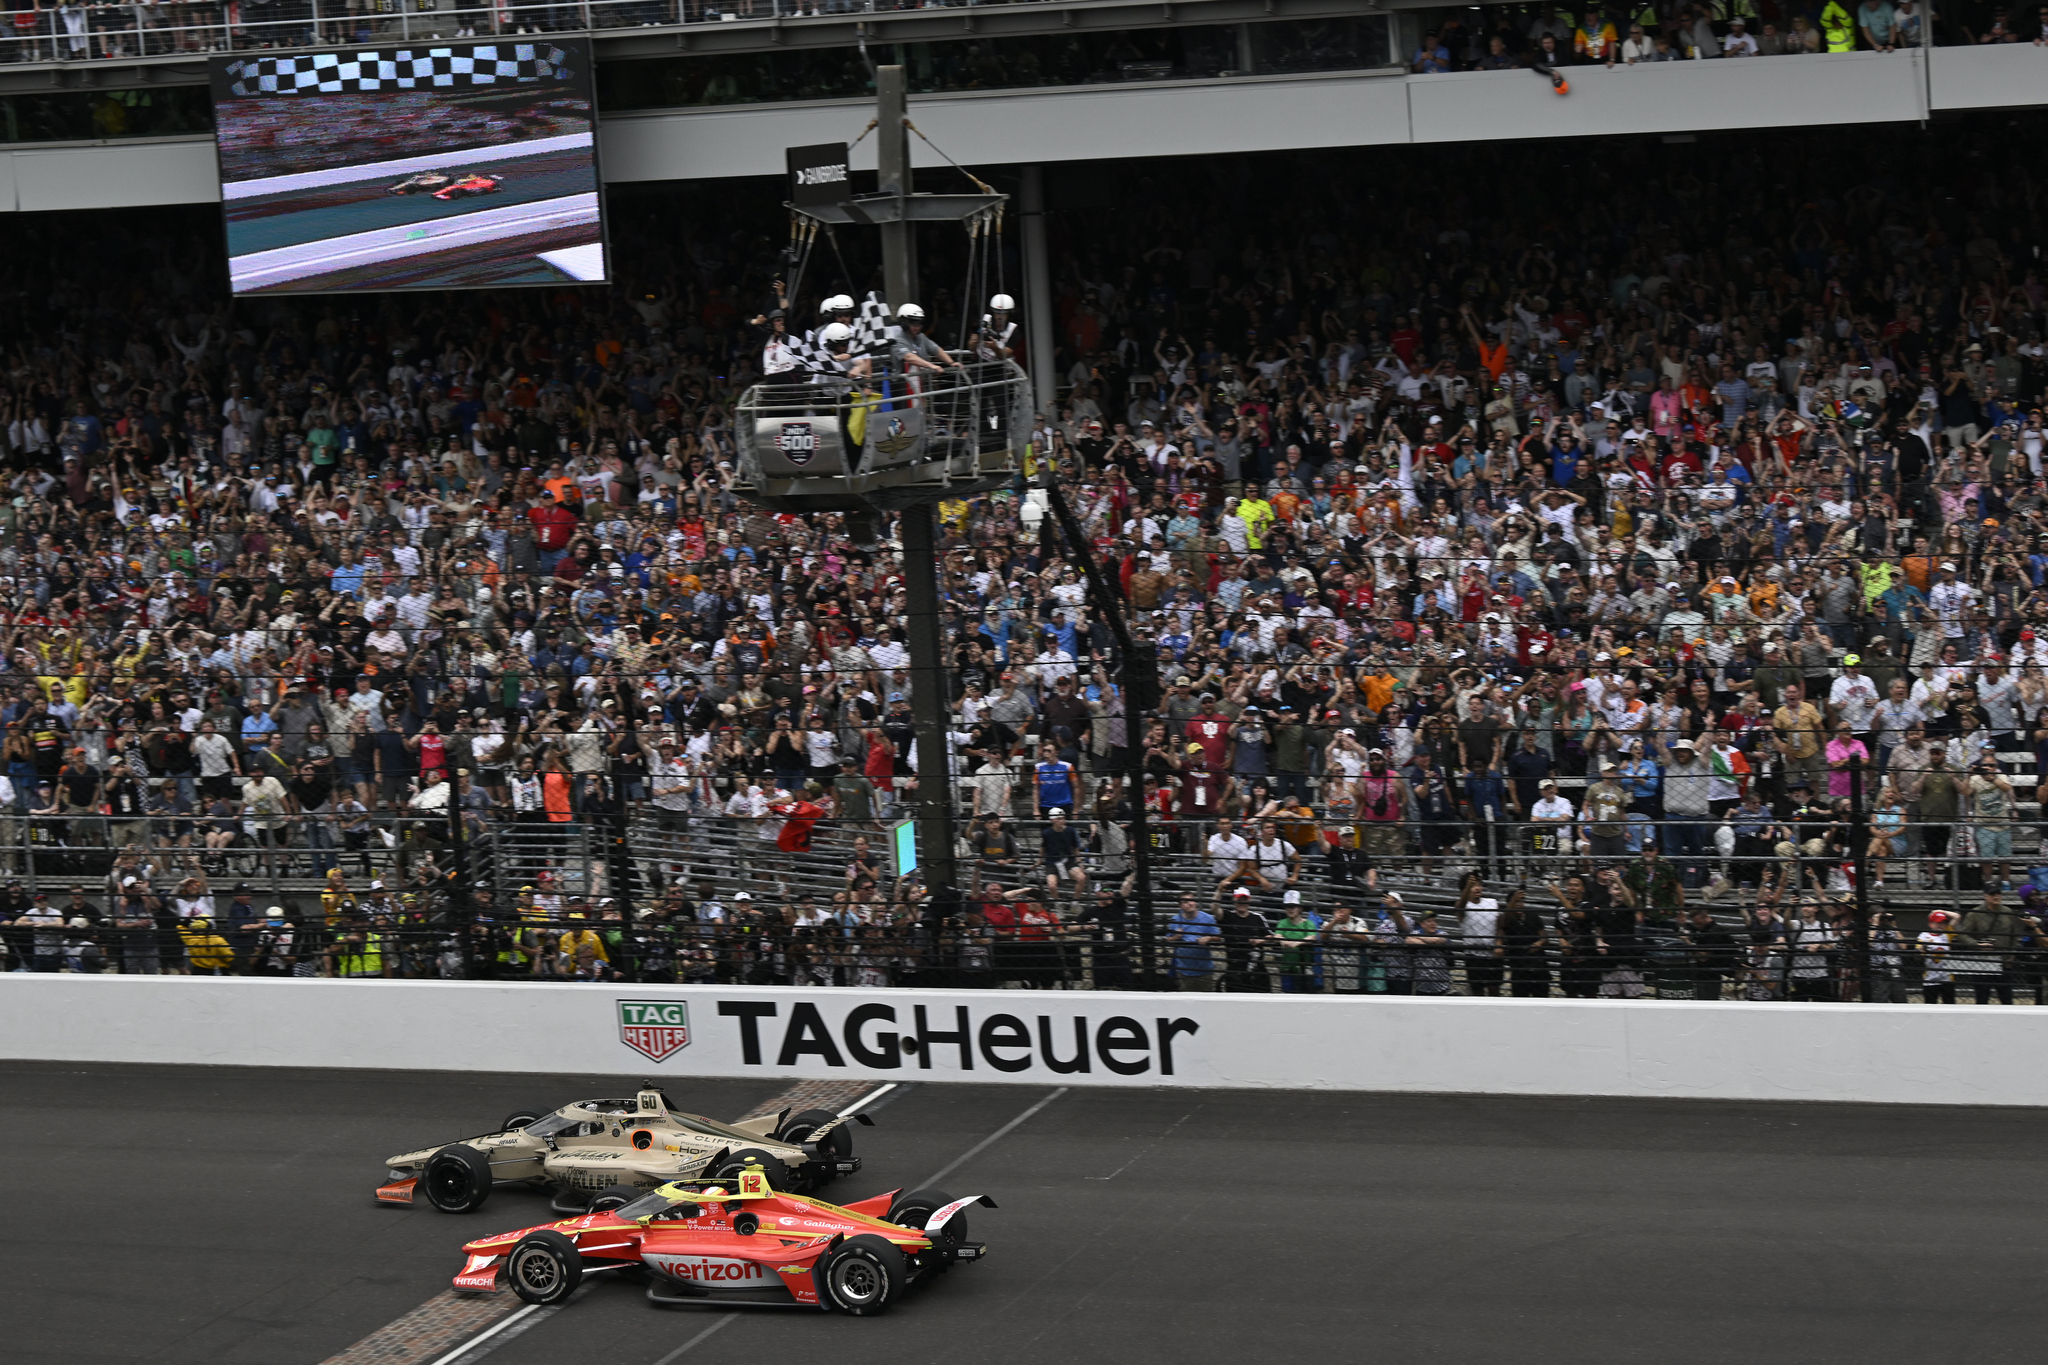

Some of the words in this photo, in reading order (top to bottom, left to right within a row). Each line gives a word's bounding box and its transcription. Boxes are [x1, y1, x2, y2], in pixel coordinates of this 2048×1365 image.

[781, 435, 814, 451] 500
[1157, 833, 1170, 848] 21
[1541, 835, 1557, 850] 22
[624, 1004, 685, 1024] TAG
[625, 1026, 686, 1052] HEUER
[717, 1000, 903, 1070] TAG
[914, 1004, 1200, 1076] Heuer
[640, 1094, 657, 1110] 60
[694, 1135, 743, 1146] CLIFFS
[742, 1175, 761, 1193] 12
[379, 1189, 411, 1199] SiriusXM
[803, 1219, 856, 1231] Gallagher
[658, 1258, 763, 1282] verizon
[455, 1277, 493, 1287] HITACHI
